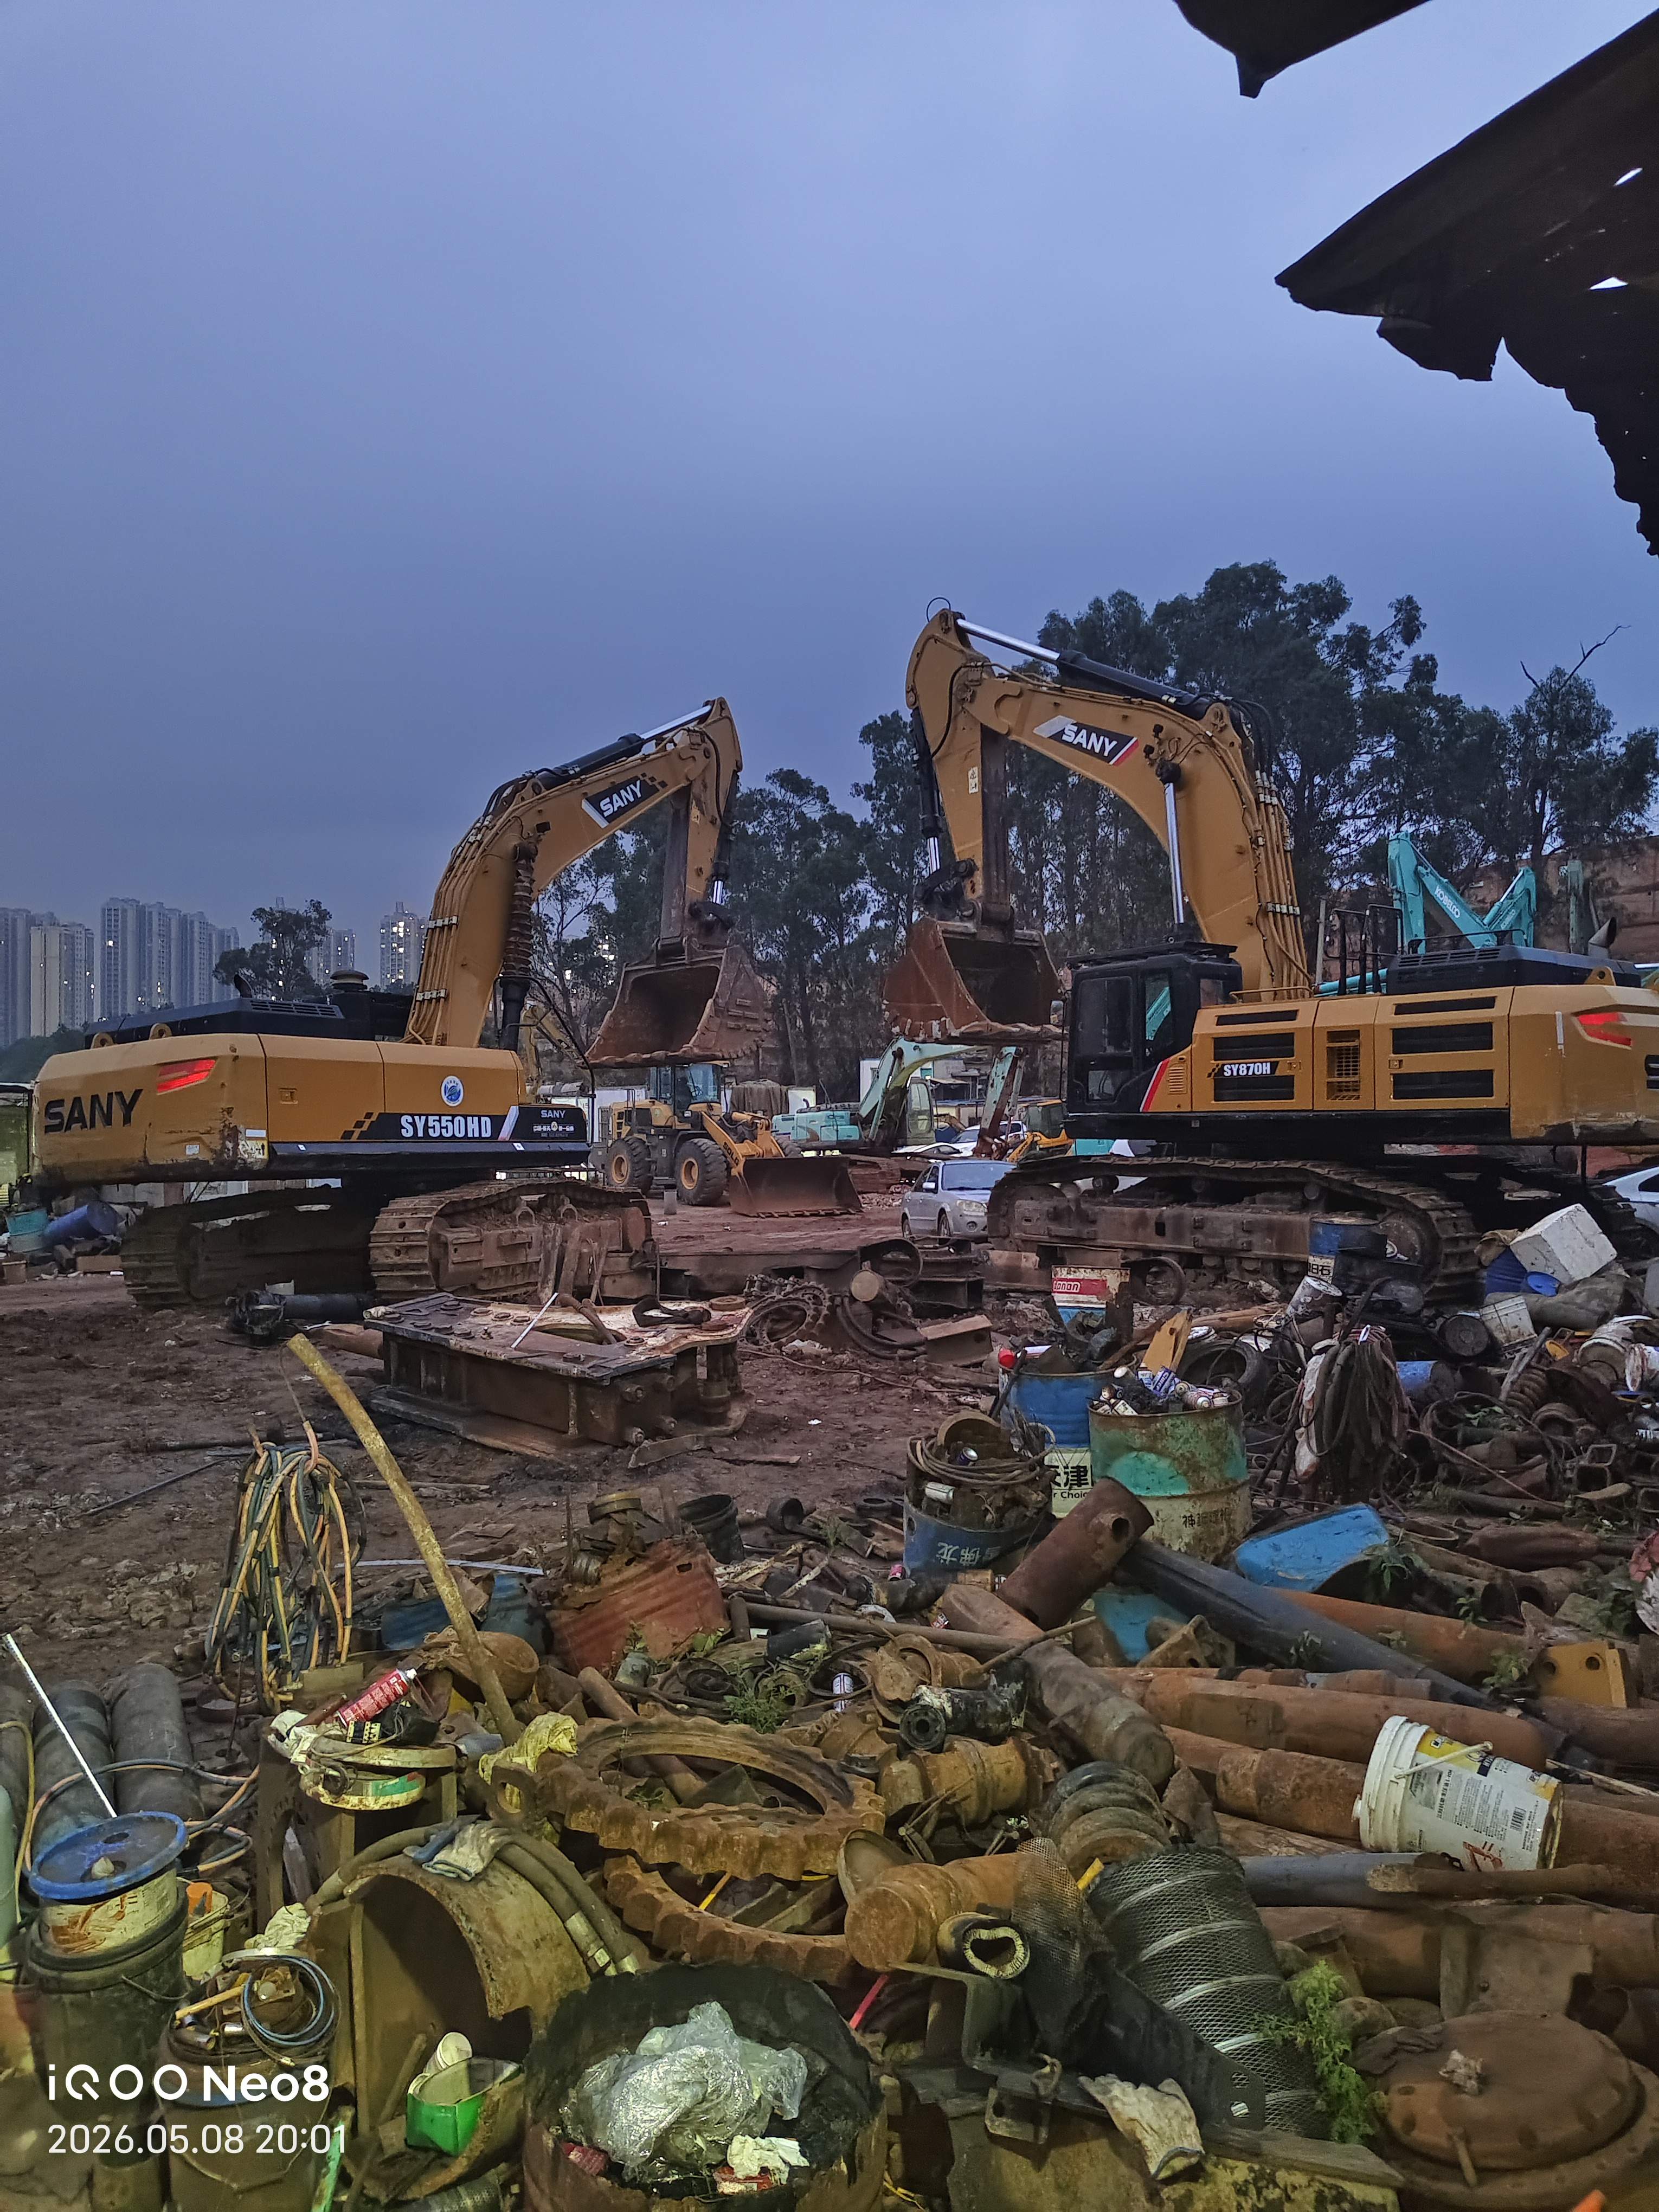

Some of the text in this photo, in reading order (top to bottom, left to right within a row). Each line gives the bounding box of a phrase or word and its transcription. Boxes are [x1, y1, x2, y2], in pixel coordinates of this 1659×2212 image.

[1062, 722, 1117, 757] SANY
[600, 780, 642, 818] SANY
[1435, 885, 1460, 918] KOBELCO
[1223, 1062, 1271, 1077] SY870H
[44, 1089, 144, 1134] SANY
[400, 1115, 492, 1138] SY550HD
[541, 1110, 565, 1118] SANY
